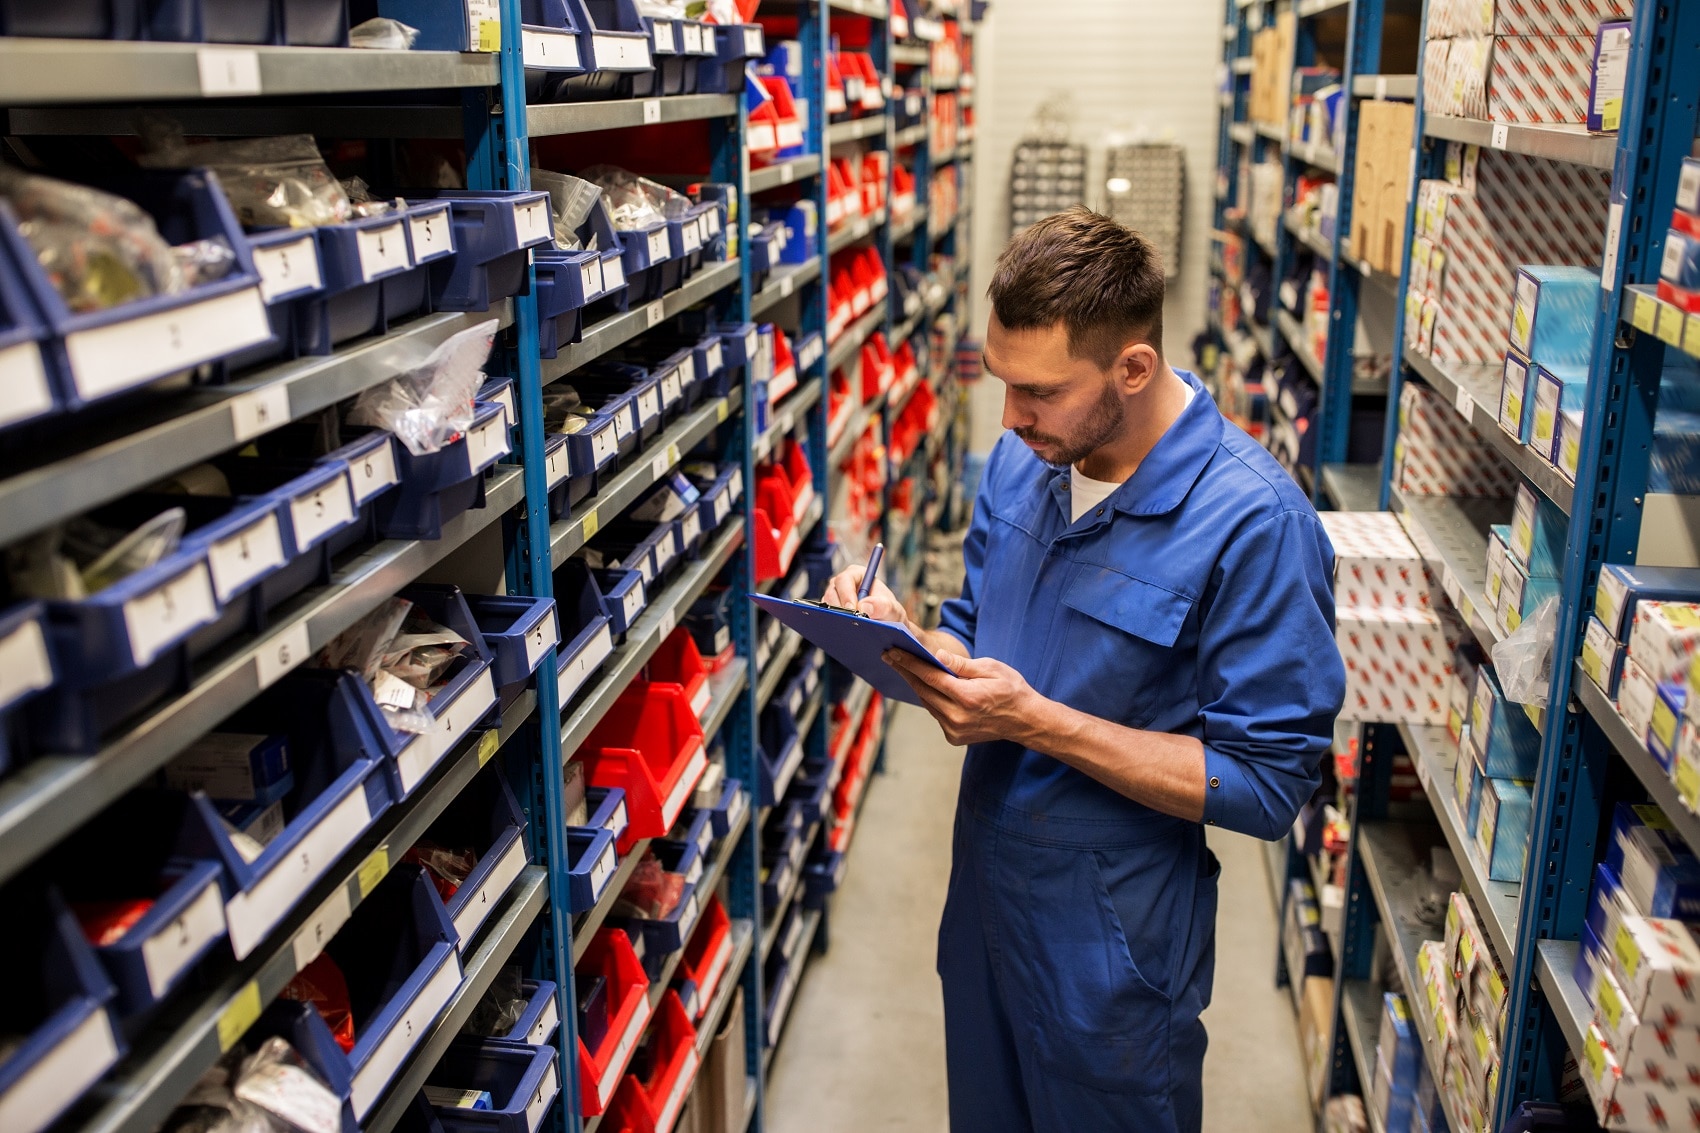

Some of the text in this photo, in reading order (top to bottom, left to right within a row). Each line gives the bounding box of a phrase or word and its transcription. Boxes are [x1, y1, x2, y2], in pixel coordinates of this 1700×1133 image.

[541, 42, 546, 56] 1
[425, 219, 432, 242] 5
[587, 267, 592, 285] 1
[364, 456, 373, 479] 6
[551, 456, 555, 473] 1
[536, 625, 543, 645] 5
